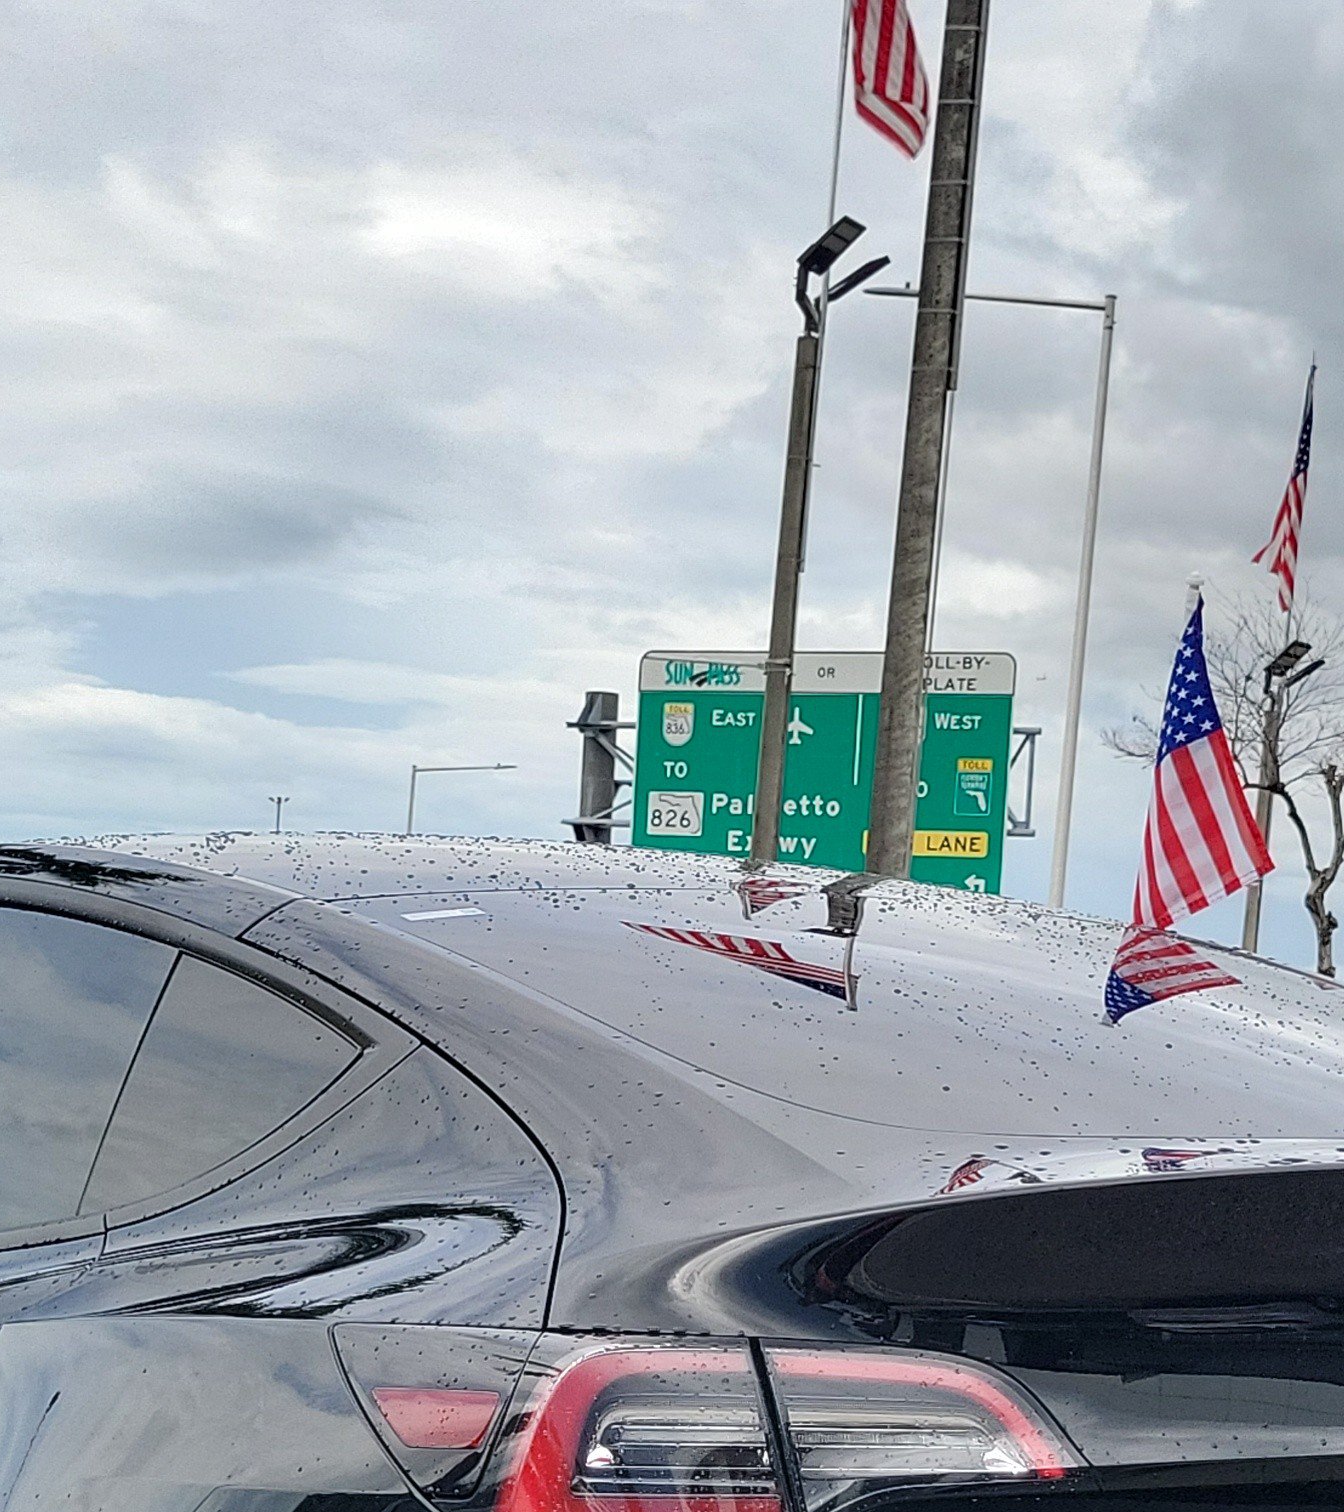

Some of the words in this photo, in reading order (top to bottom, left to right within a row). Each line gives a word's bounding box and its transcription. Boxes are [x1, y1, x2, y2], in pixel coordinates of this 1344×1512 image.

[922, 656, 991, 670] OLL-BY-
[817, 667, 836, 679] OR
[922, 677, 978, 692] PLATE
[712, 709, 756, 727] EAST
[934, 712, 982, 730] WEST
[666, 722, 685, 735] 836
[663, 761, 688, 778] TO
[916, 781, 929, 798] O
[711, 793, 841, 817] Paletto
[650, 808, 692, 829] 826
[727, 830, 817, 860] Ewy
[926, 836, 982, 853] LANE
